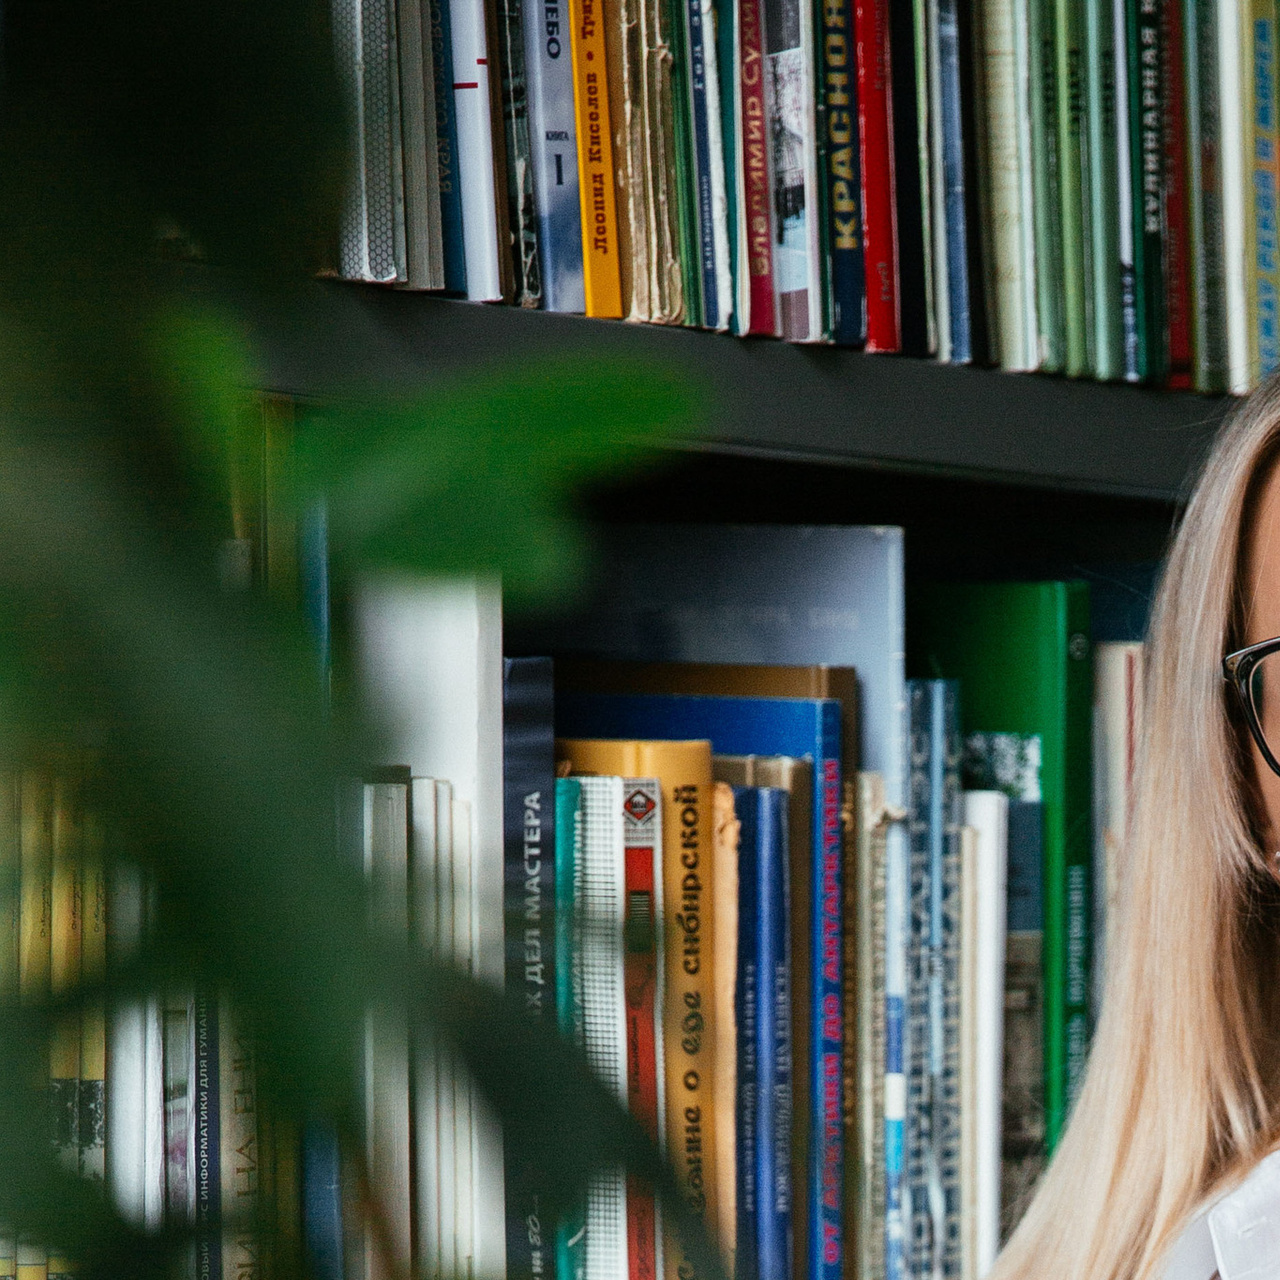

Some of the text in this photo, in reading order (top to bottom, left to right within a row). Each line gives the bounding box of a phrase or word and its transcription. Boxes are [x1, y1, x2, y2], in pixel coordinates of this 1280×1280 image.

[584, 72, 602, 164] Киселев
[591, 173, 608, 255] Леонид
[746, 96, 770, 276] Владимир
[523, 791, 542, 920] МАСТЕРА
[673, 784, 703, 975] сибирской
[822, 757, 841, 983] АНТАРКТИКИ
[524, 928, 545, 986] ДЕЛ
[680, 990, 704, 1056] еде
[822, 994, 843, 1043] ДО
[198, 1058, 210, 1089] ДЛЯ
[683, 1069, 702, 1092] о
[198, 1090, 211, 1199] ИНФОРМАТИКИ
[822, 1052, 841, 1211] АРКТИКИ
[823, 1221, 841, 1265] ОТ
